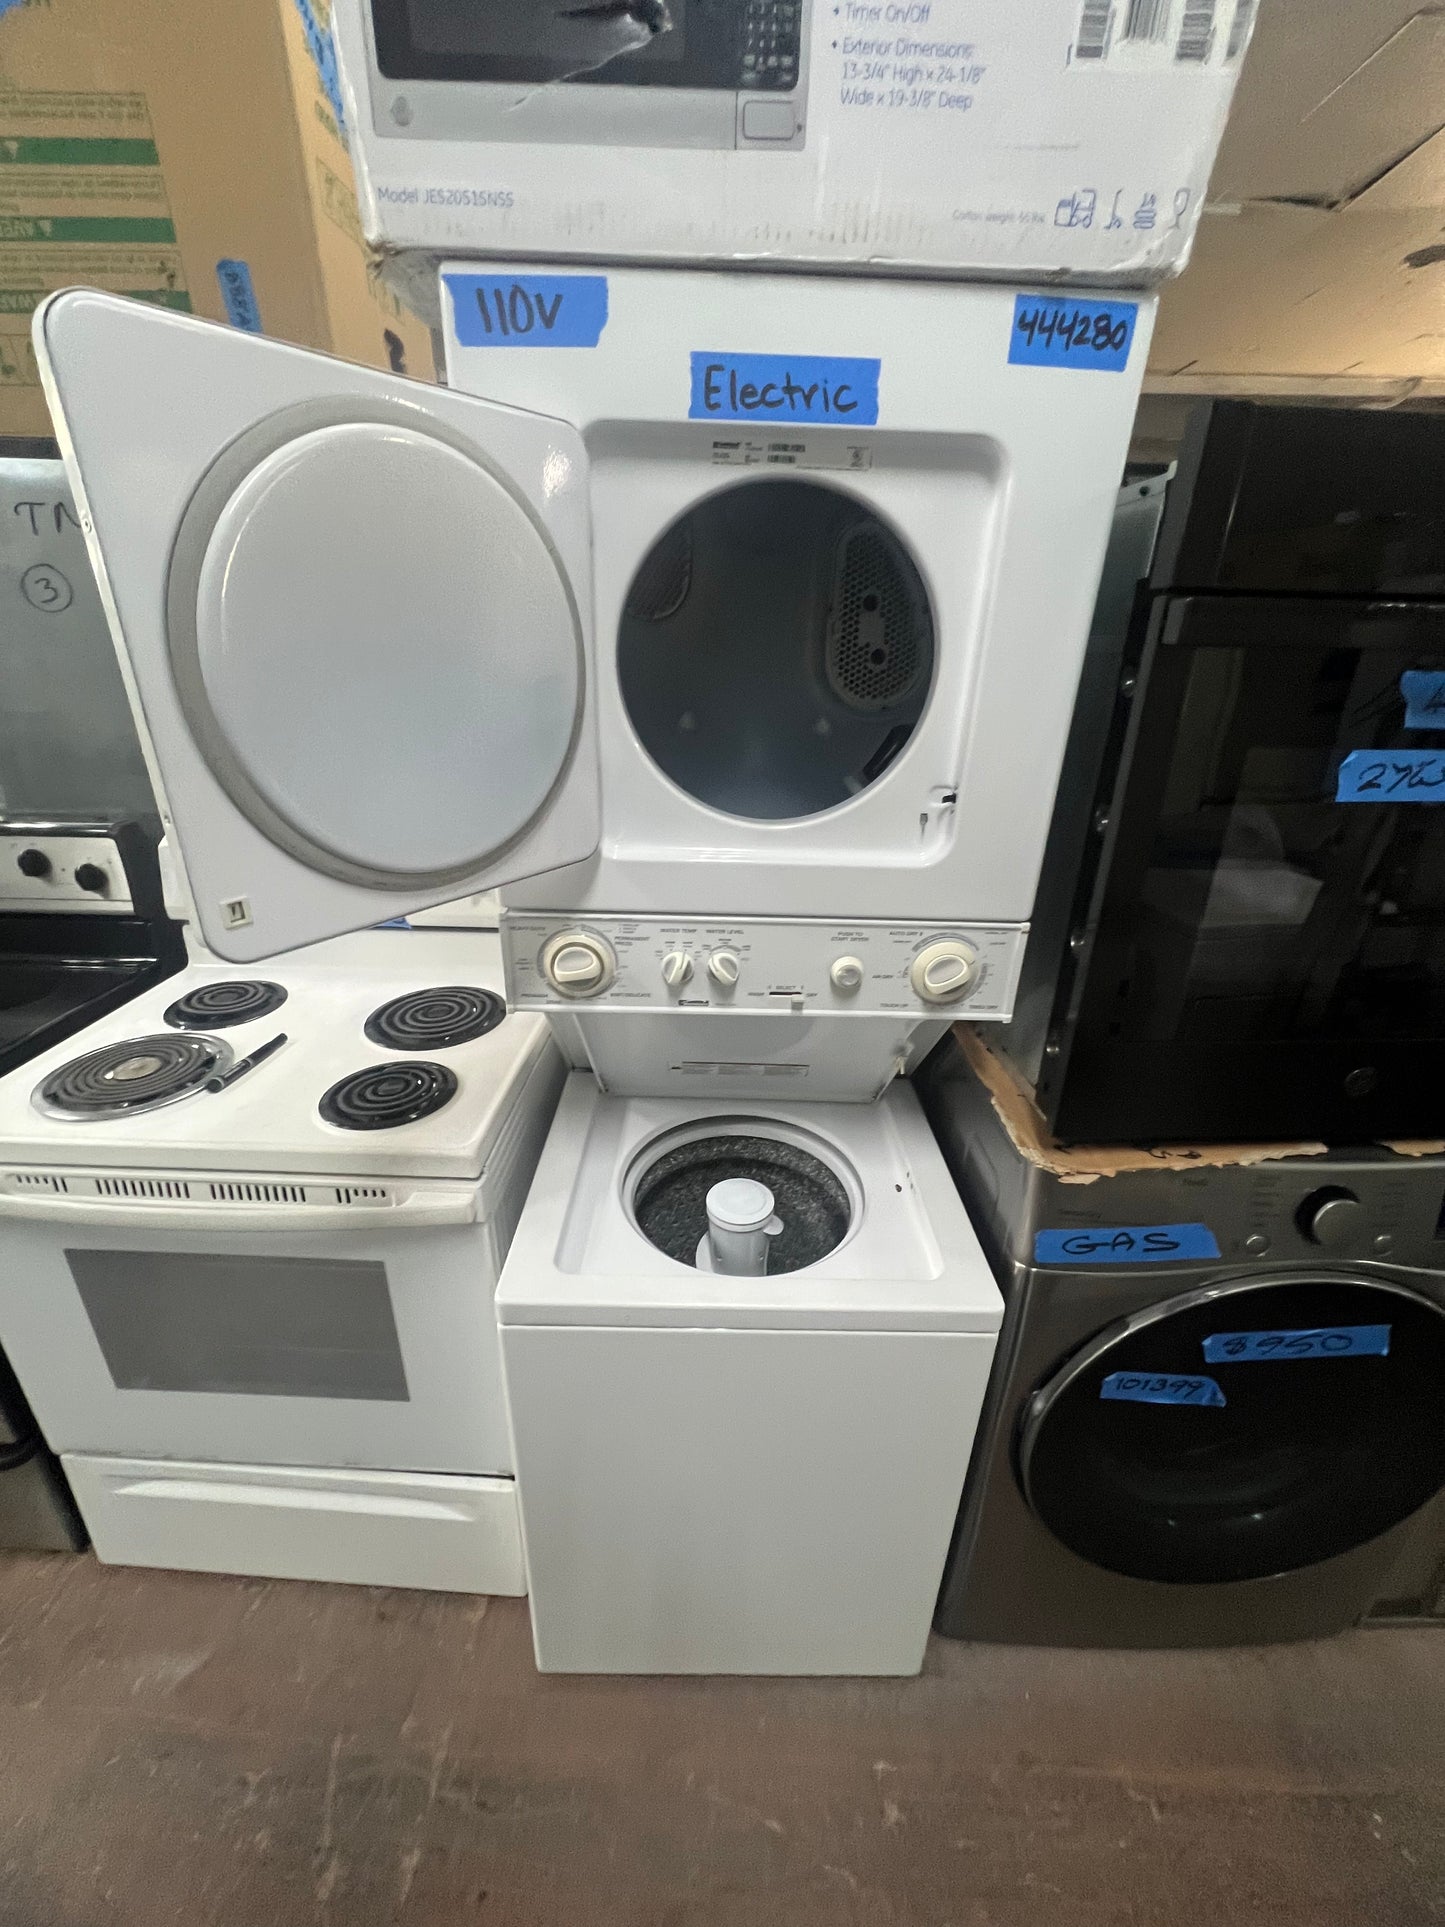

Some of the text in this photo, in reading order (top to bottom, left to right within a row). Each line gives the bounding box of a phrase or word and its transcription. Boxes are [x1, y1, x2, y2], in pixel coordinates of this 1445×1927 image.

[846, 3, 930, 23] Timer On/Off
[843, 37, 892, 55] Exterior
[893, 65, 922, 86] High
[841, 87, 874, 106] Wide
[939, 91, 972, 111] Deep
[378, 187, 418, 204] Model
[1017, 308, 1128, 352] 444280
[704, 364, 858, 413] Electric
[1062, 1231, 1181, 1255] GAS
